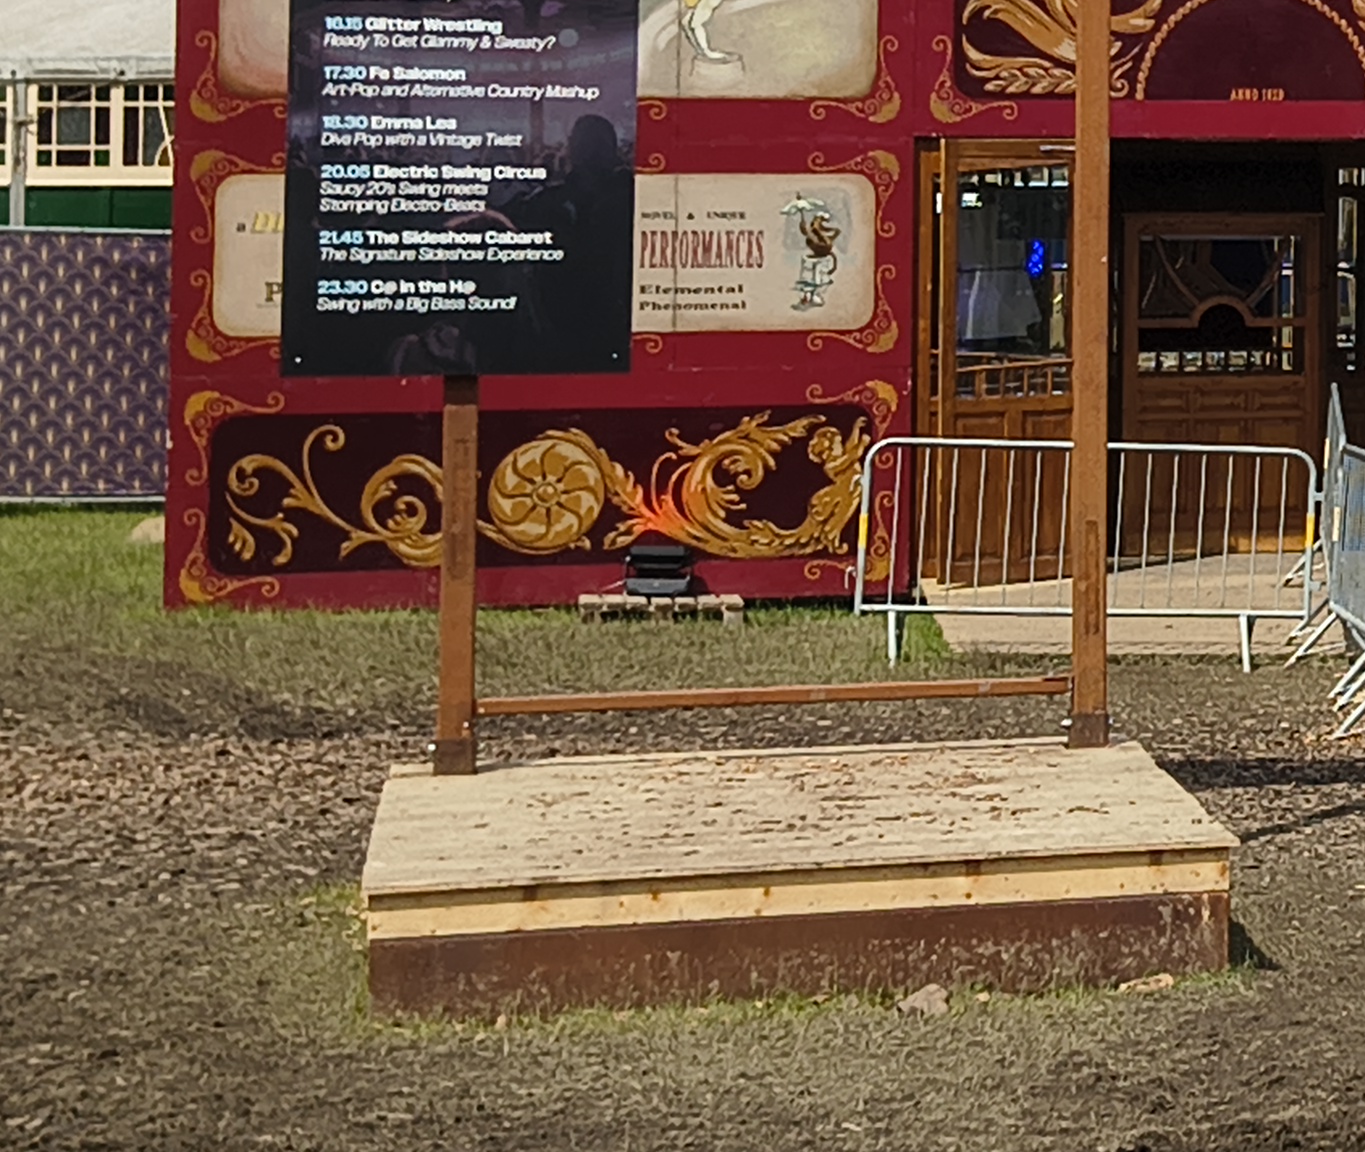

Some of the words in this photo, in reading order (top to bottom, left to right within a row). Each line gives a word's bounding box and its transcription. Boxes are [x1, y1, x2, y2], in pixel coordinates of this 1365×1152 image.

[364, 17, 422, 32] Glitter
[423, 18, 503, 35] Wrestling
[324, 33, 370, 50] Ready
[372, 34, 389, 48] To
[392, 34, 418, 48] Get
[421, 34, 479, 52] Glammy
[480, 35, 493, 48] &
[494, 35, 557, 52] Sweaty?
[324, 66, 367, 80] 17.30
[369, 66, 390, 80] Fe
[393, 66, 466, 81] Salomon
[321, 82, 381, 100] Art-Pop
[381, 83, 409, 97] and
[410, 84, 485, 98] Alternative
[487, 84, 545, 101] Country
[545, 85, 599, 101] Mashup
[370, 116, 423, 130] Emma
[354, 132, 382, 149] Pop
[385, 132, 416, 146] with
[417, 136, 427, 146] a
[429, 132, 483, 149] Vintage
[485, 132, 523, 147] Twist
[320, 164, 370, 179] 20.05
[373, 165, 438, 179] Electric
[441, 165, 492, 182] Swing
[493, 165, 547, 180] Circus
[320, 181, 366, 198] Saucy
[398, 182, 441, 198] Swing
[442, 183, 489, 195] meets
[319, 198, 389, 215] Stomping
[366, 231, 400, 245] The
[401, 231, 482, 245] Sideshow
[484, 231, 554, 245] Cabaret
[320, 247, 347, 261] The
[349, 247, 417, 264] Signature
[418, 247, 486, 261] Sideshow
[486, 247, 565, 264] Experience
[640, 230, 764, 268] PERFORMANCES
[317, 280, 368, 295] 23.30
[400, 280, 415, 294] in
[417, 280, 446, 294] the
[639, 284, 744, 295] Elemental
[316, 297, 360, 314] Swing
[362, 297, 393, 311] with
[394, 300, 405, 311] a
[406, 297, 429, 314] Big
[431, 297, 466, 311] Bass
[639, 300, 747, 311] Phenomenal
